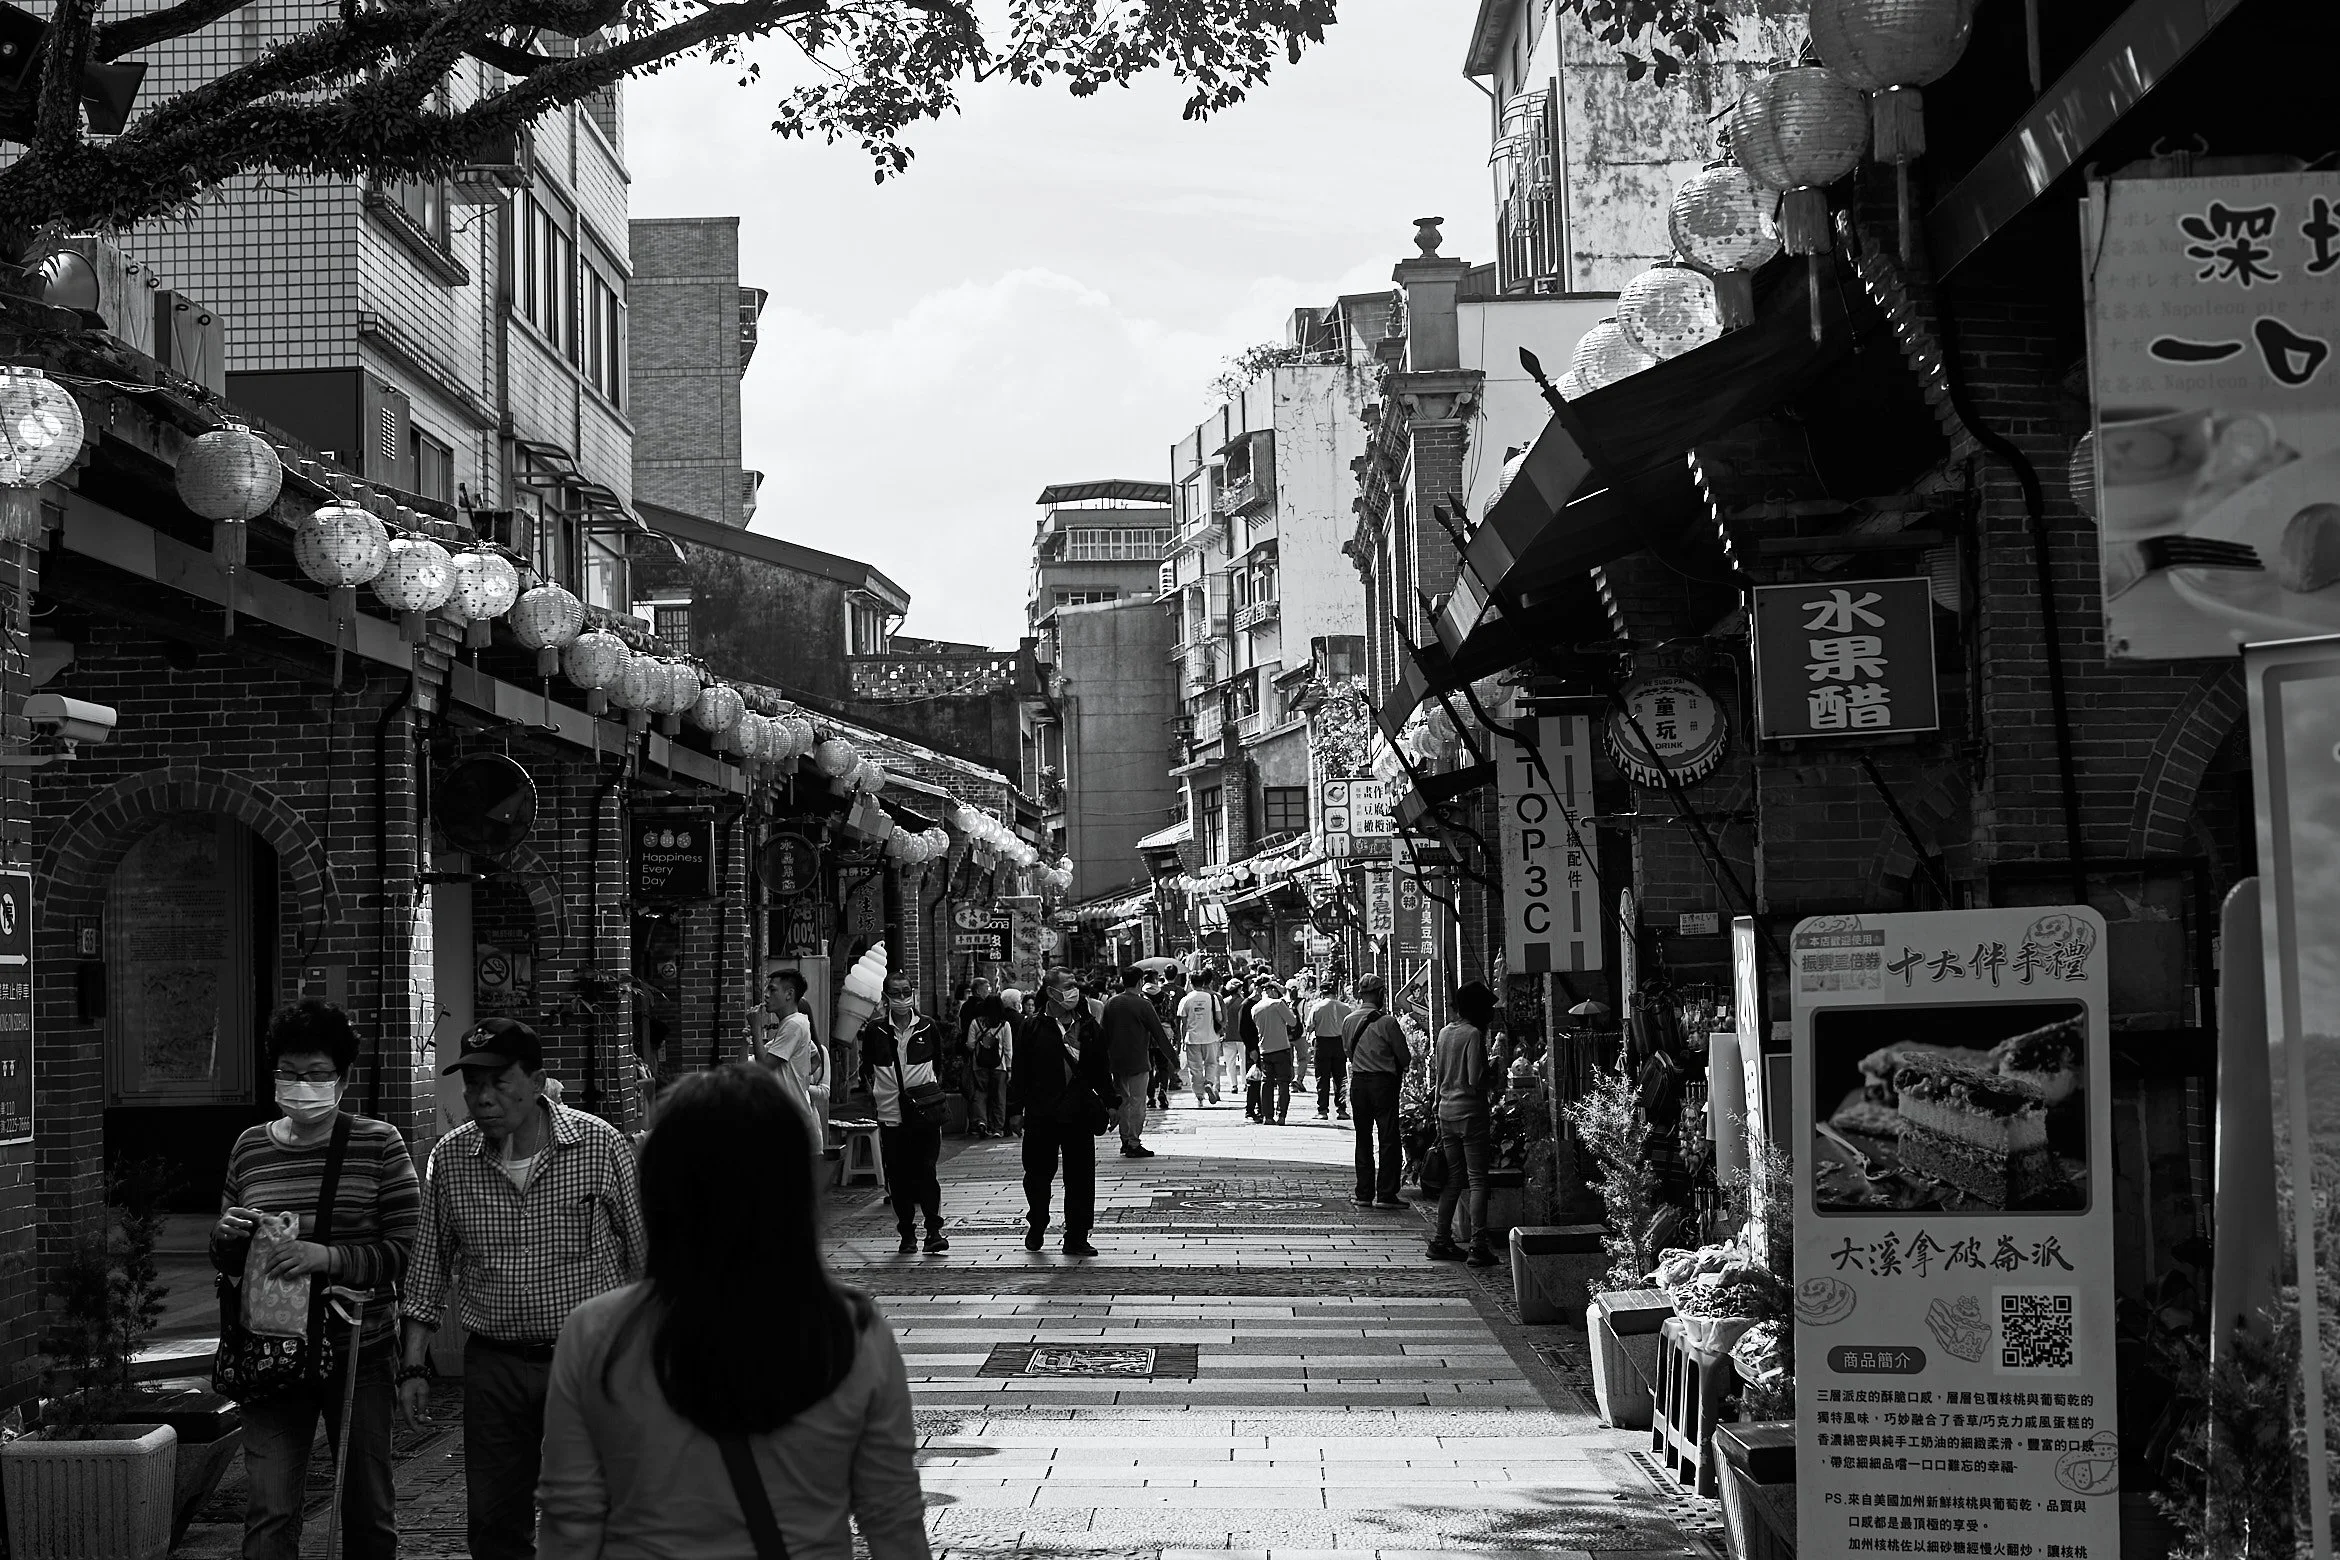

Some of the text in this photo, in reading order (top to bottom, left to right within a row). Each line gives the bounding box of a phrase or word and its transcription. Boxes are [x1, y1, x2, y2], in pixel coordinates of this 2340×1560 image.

[1802, 588, 1892, 730] 水果醋
[1655, 696, 1677, 740] 童玩
[1655, 741, 1683, 750] DRINK
[1565, 809, 1583, 888] 手機配件
[642, 853, 703, 863] Happiness
[642, 865, 674, 875] Every
[642, 876, 666, 887] Day
[984, 920, 1010, 929] ona
[1809, 934, 1872, 946] 本店歡迎使用
[1802, 951, 1881, 973] 振興三倍券
[1887, 937, 2088, 988] 十大伴手禮
[0, 983, 30, 1000] 禁止停車
[1831, 1229, 2074, 1278] 大溪拿破崙派
[1844, 1351, 1912, 1369] 商品簡介
